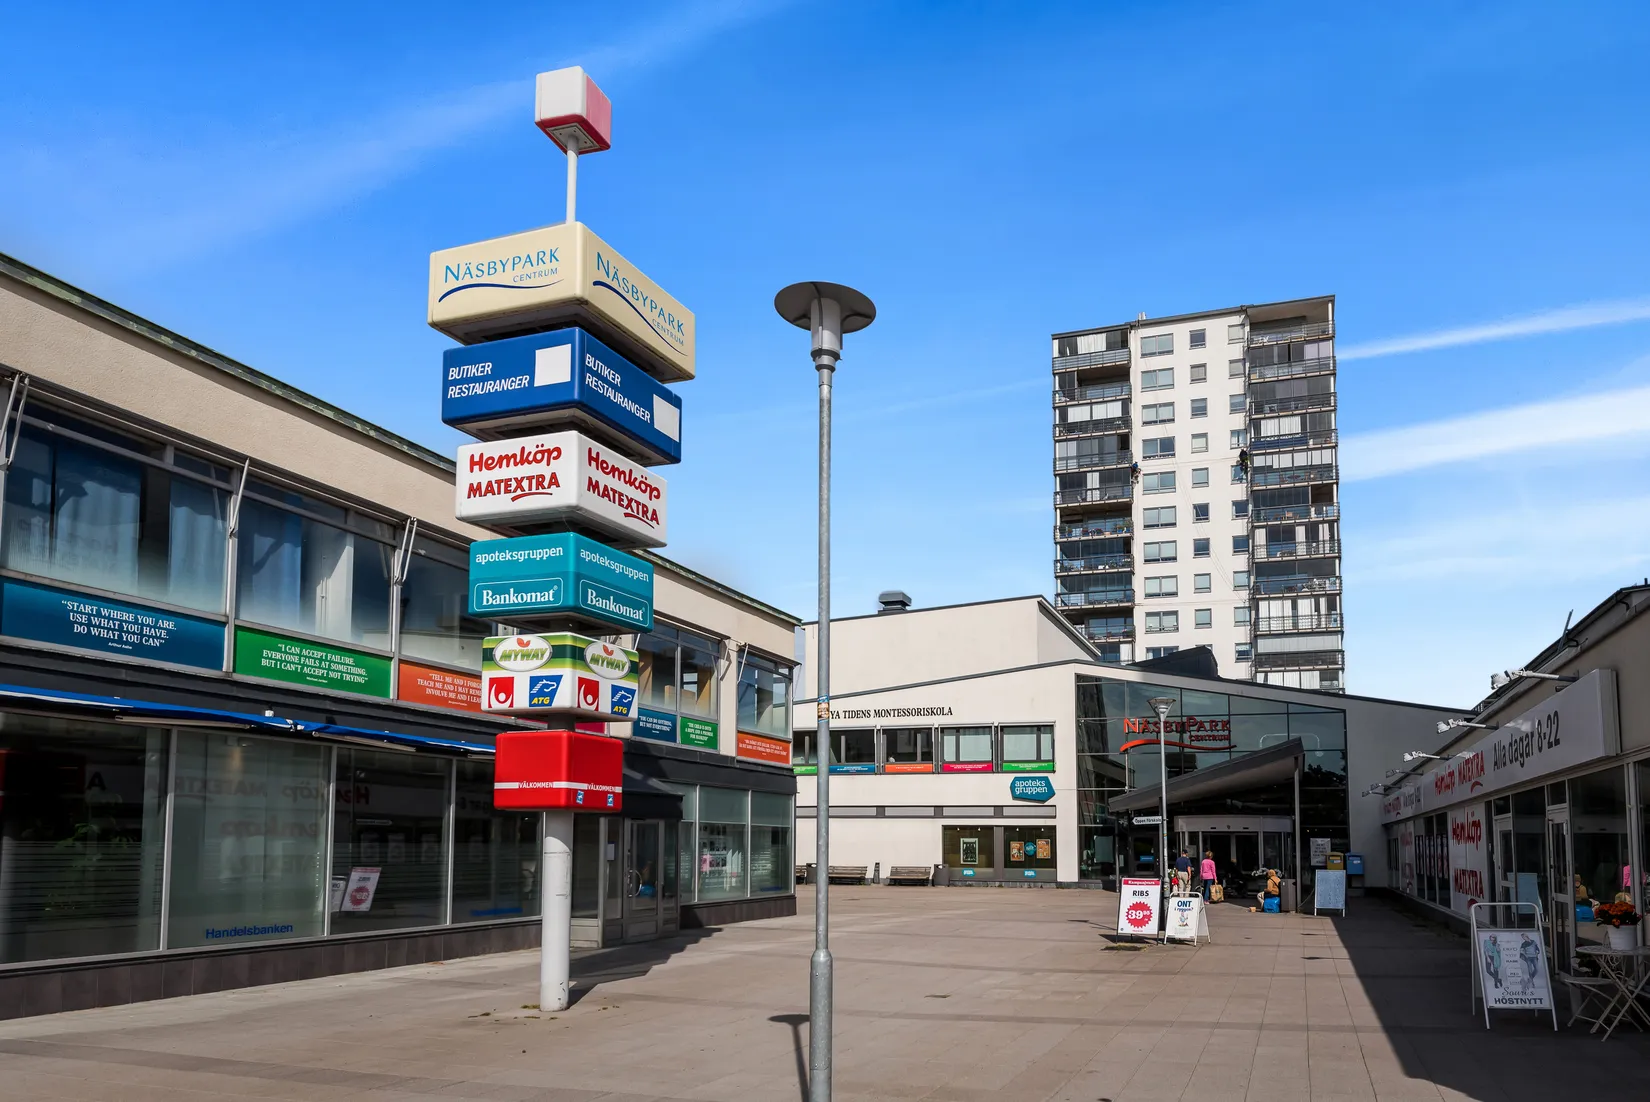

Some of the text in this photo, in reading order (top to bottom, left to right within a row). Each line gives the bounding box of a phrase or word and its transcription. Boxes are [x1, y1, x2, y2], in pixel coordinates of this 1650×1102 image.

[444, 247, 560, 283] NÄSBYPARK
[513, 268, 558, 282] CENTRUM
[596, 252, 685, 336] NÄSBYPARK
[652, 318, 684, 346] CENTRUM
[448, 362, 492, 380] BUTIKER
[586, 353, 621, 387] BUTIKER
[448, 375, 530, 398] RESTAURANGER
[586, 372, 651, 424] RESTAURANGER
[469, 443, 562, 473] Hemköp
[588, 448, 661, 500] Hemköp
[466, 472, 560, 499] MATEXTRA
[586, 476, 660, 526] MATEXTRA
[475, 546, 564, 564] apoteksgruppen
[580, 548, 649, 582] apoteksgruppen
[70, 612, 169, 638] USE WHAT YOU HAVE.
[100, 608, 135, 622] WHERE
[137, 614, 156, 626] YOU
[157, 620, 176, 630] ARE.
[74, 624, 88, 634] DO
[90, 627, 120, 640] WHAT
[122, 632, 140, 643] YOU
[262, 650, 300, 664] EVERYONE
[300, 657, 320, 666] FAILS
[286, 646, 300, 654] CAN
[302, 648, 326, 660] ACCEPT
[328, 654, 356, 666] FAILURE.
[261, 659, 276, 668] BUT
[302, 667, 328, 677] ACCEPT
[328, 671, 341, 680] NOT
[426, 688, 447, 697] INVOLVE
[531, 696, 550, 704] ATG
[612, 706, 628, 714] ATG
[842, 710, 871, 719] TIDENS
[873, 706, 953, 718] MONTESSORISKOLA
[1188, 734, 1230, 742] CENTRUM
[1458, 750, 1485, 786] MATEXTRA
[1494, 740, 1506, 772] Alla
[1509, 733, 1534, 768] dagar
[1537, 710, 1560, 754] 8-22
[588, 782, 616, 792] VÄLKOMMEN
[1014, 786, 1048, 794] gruppen
[1452, 811, 1482, 851] Hemköp
[206, 924, 294, 940] Handelsbanken
[1494, 996, 1543, 1004] HÖSTNYTT
